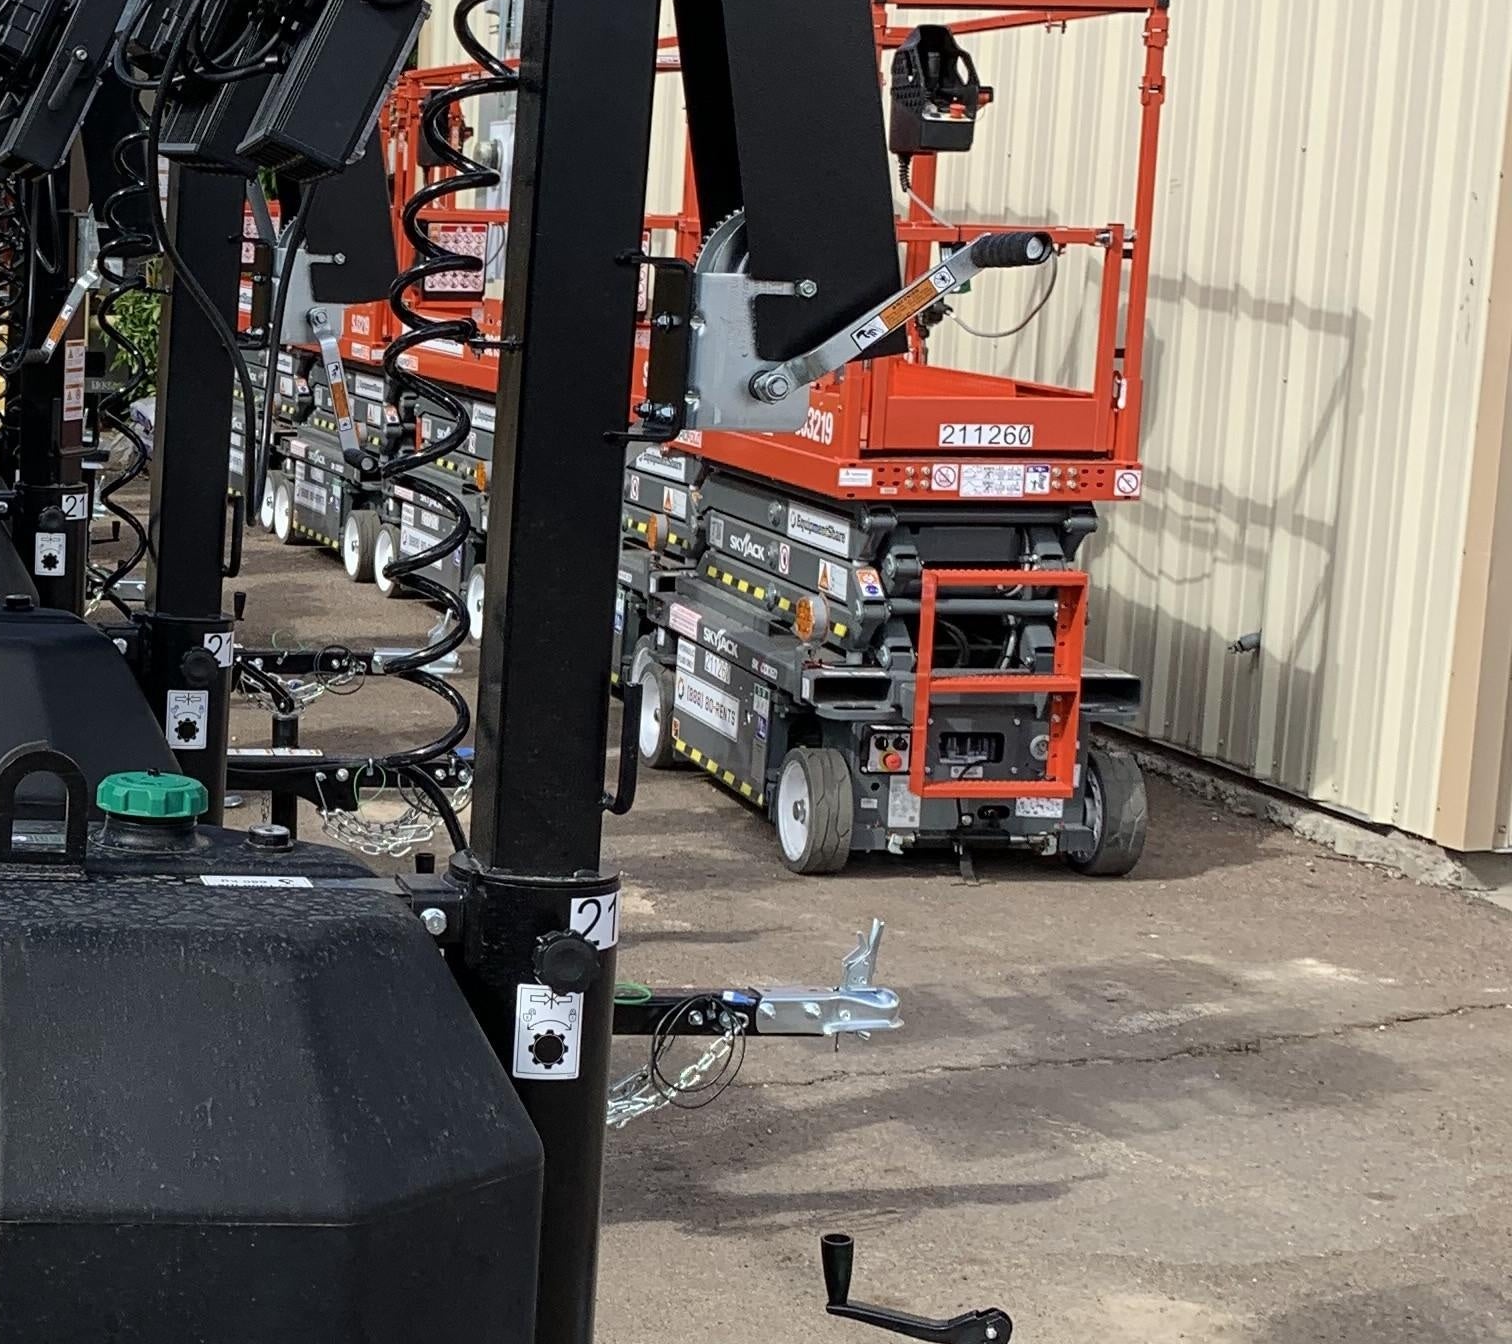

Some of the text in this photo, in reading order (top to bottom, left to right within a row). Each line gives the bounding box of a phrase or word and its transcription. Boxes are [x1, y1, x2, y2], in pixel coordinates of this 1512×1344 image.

[941, 425, 1031, 445] 211260
[729, 532, 765, 562] SKYJACK
[703, 626, 739, 659] SKYJACK
